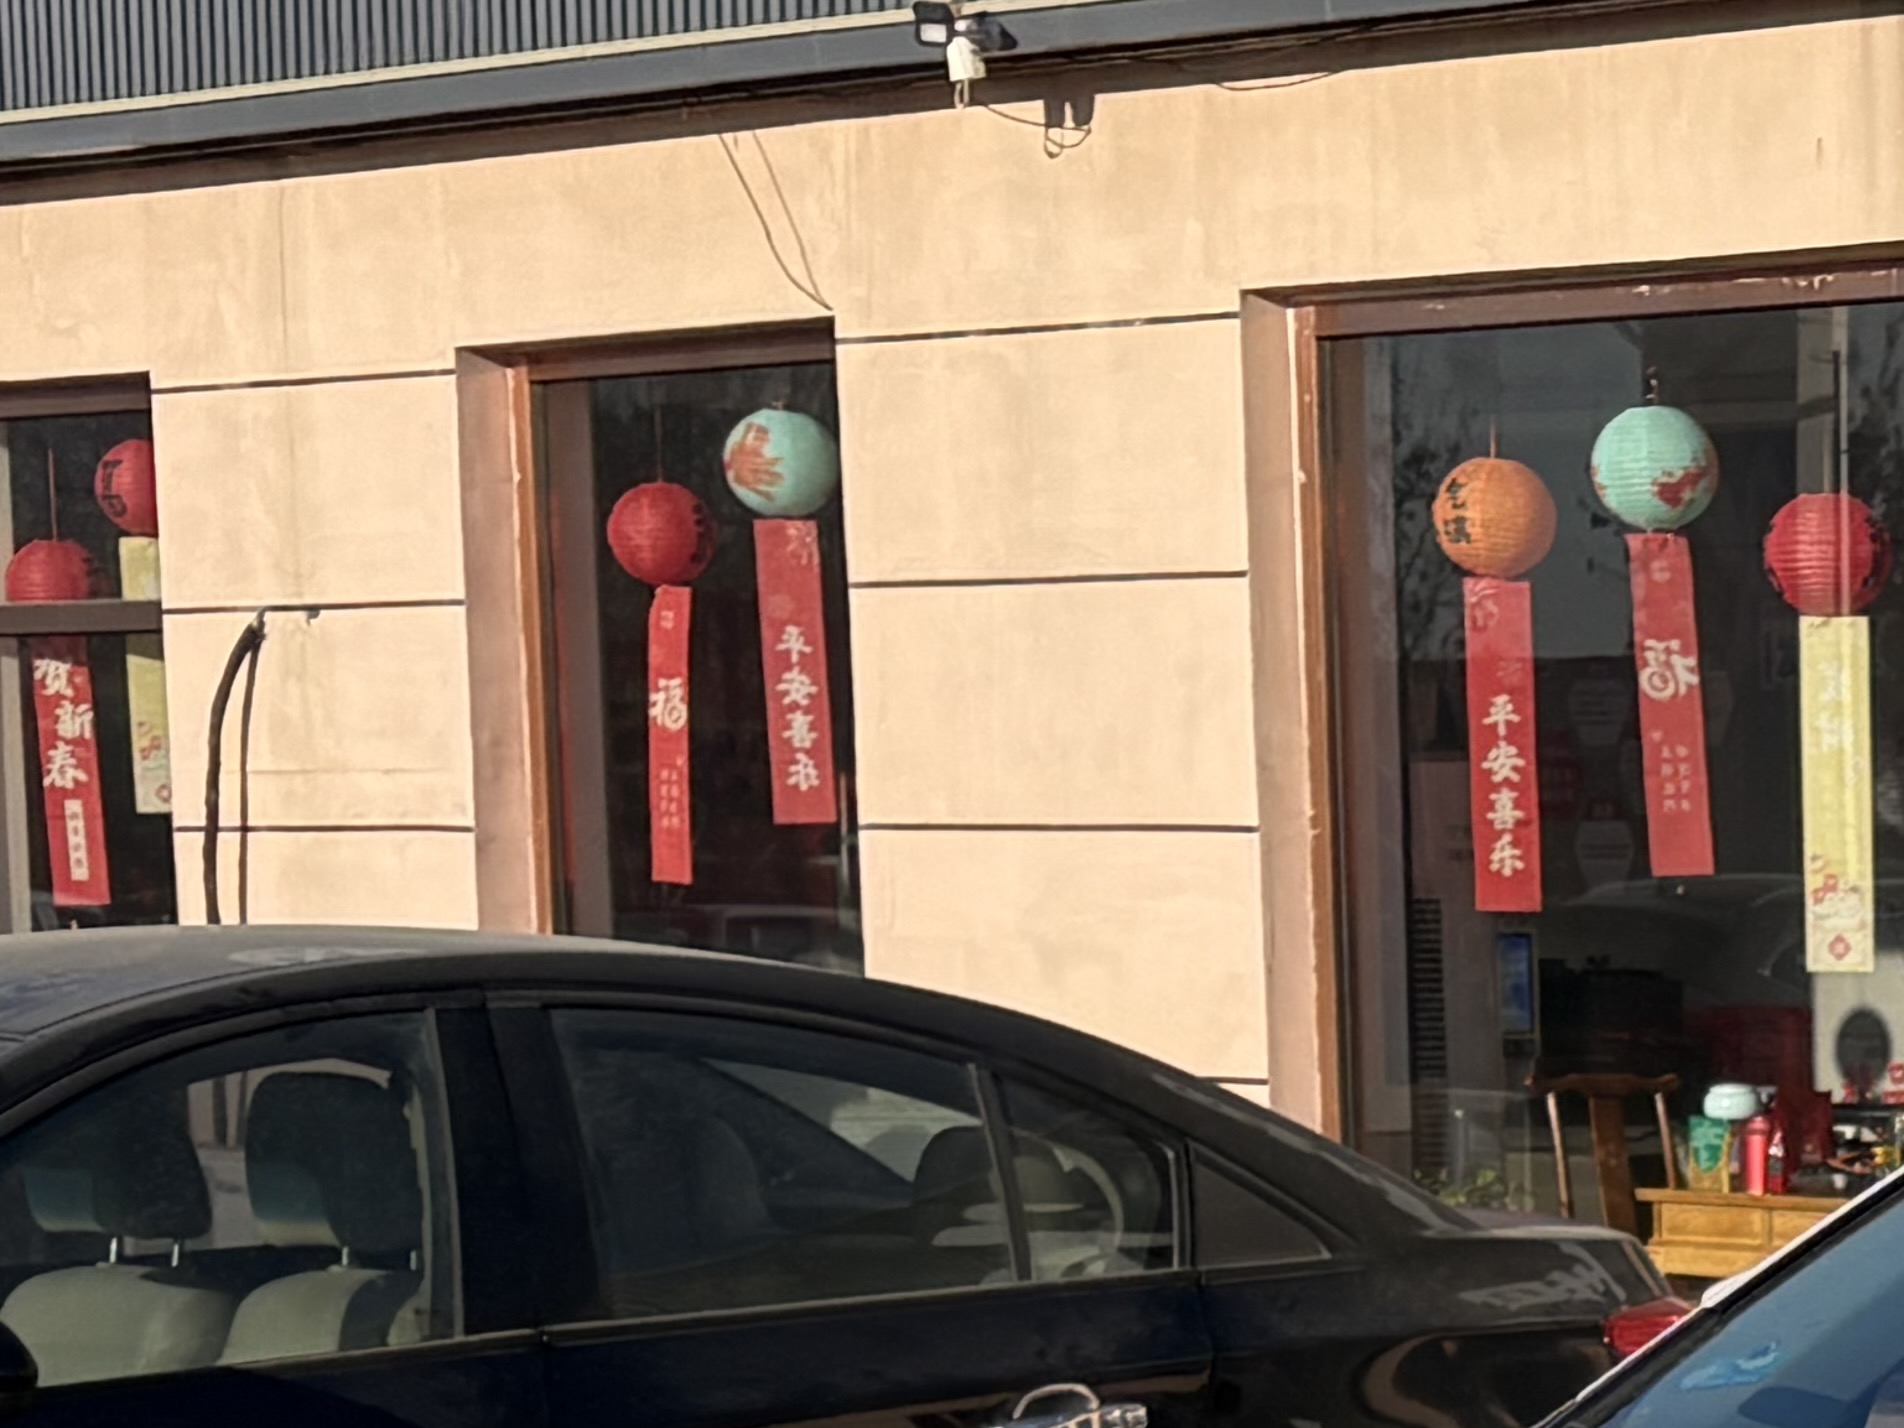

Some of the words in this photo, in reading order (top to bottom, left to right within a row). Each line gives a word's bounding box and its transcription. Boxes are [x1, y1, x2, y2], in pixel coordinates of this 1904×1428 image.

[33, 658, 94, 790] 贺新春
[648, 677, 688, 731] 福
[1480, 693, 1526, 877] 平安喜乐
